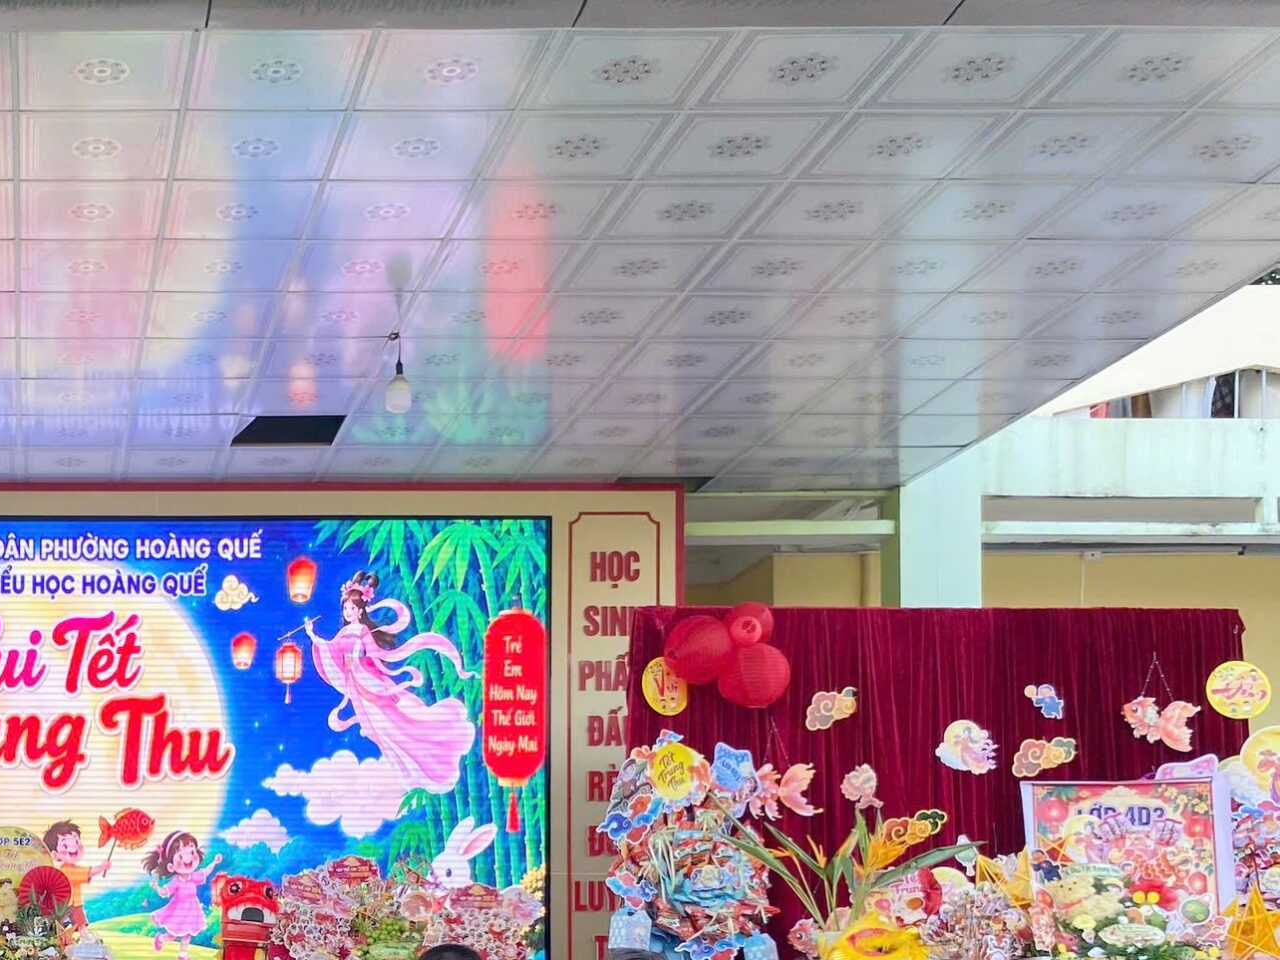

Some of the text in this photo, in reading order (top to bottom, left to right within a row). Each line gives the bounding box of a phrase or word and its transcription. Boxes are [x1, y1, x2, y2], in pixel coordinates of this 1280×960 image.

[41, 532, 129, 560] PHƯỜNG
[135, 532, 211, 560] HOÀNG
[217, 529, 263, 560] QUẾ
[32, 573, 75, 600] HỌC
[81, 569, 156, 595] HOÀNG
[162, 563, 207, 596] QUẾ
[590, 551, 640, 588] HỌC
[583, 605, 637, 637] SIN
[51, 610, 143, 694] Tết
[503, 659, 523, 678] Em
[578, 651, 630, 691] PHẤ
[488, 683, 538, 705] Hôm Nay
[99, 692, 232, 785] Thu
[587, 706, 629, 747] ĐẤ
[518, 735, 538, 753] Mai
[657, 760, 685, 784] Trung
[13, 837, 31, 846] 5E2
